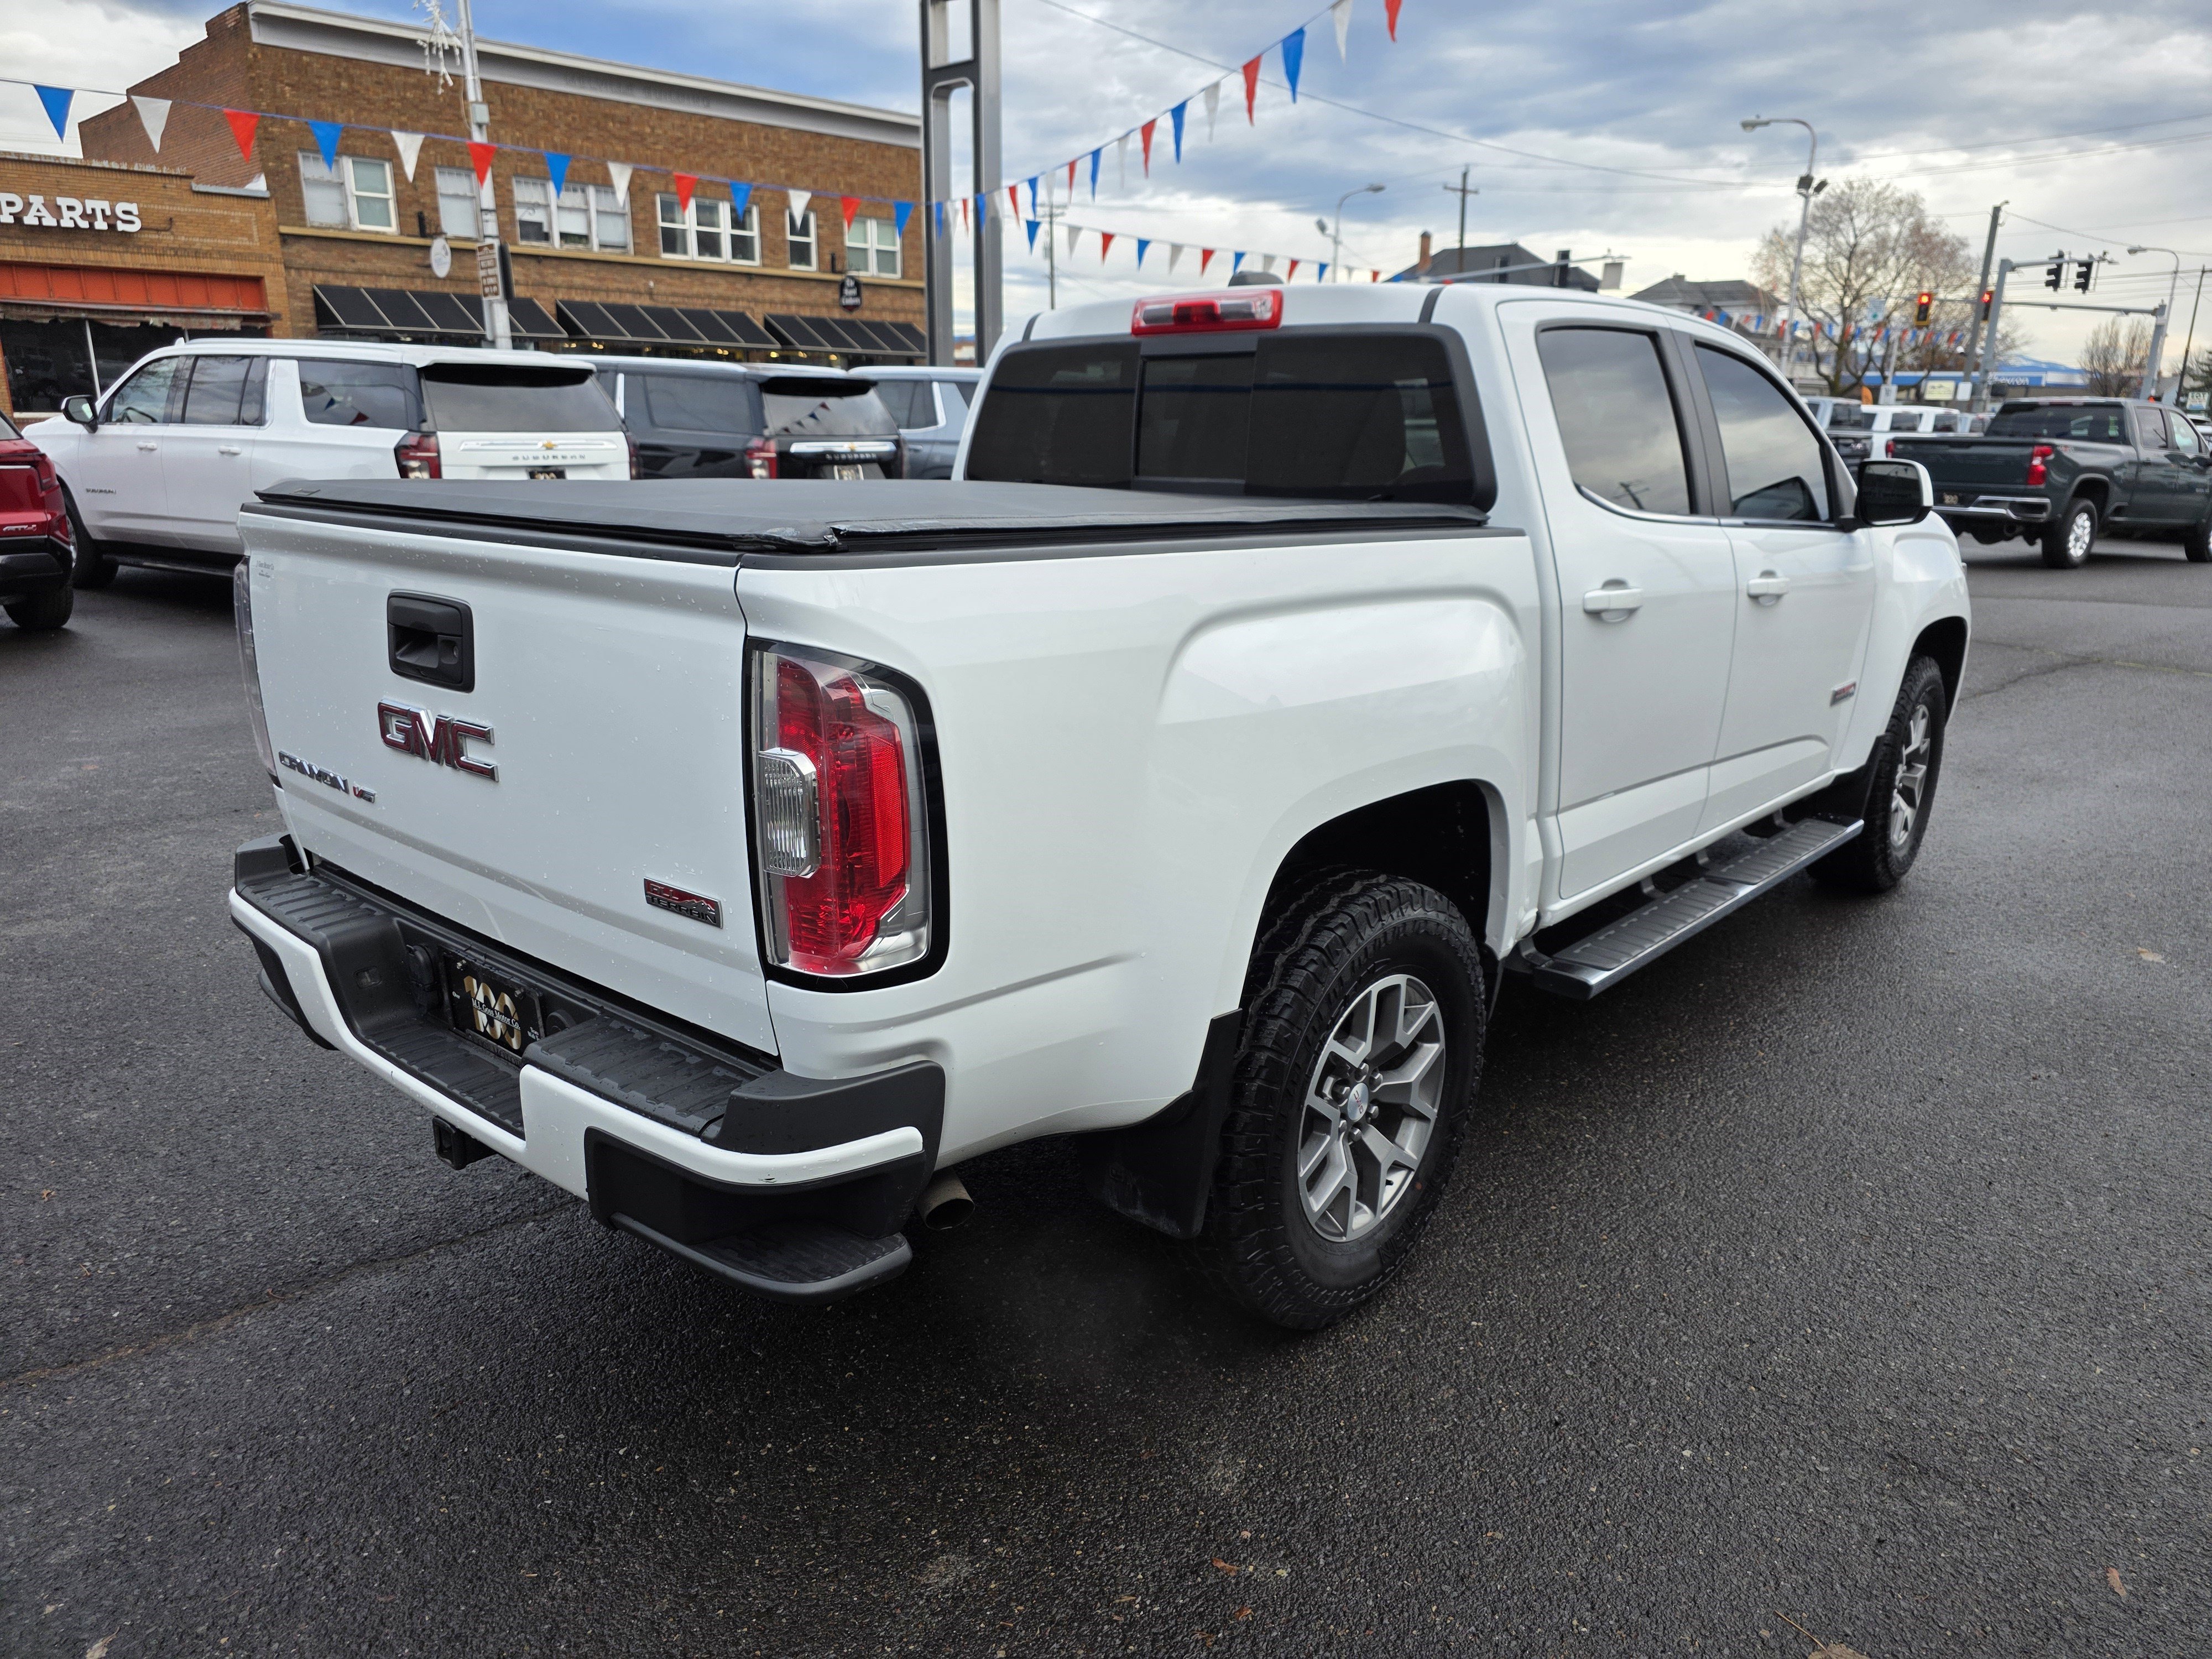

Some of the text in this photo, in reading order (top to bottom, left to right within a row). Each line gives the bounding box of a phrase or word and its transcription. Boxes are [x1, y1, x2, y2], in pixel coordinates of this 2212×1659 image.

[0, 192, 142, 233] PARTS
[378, 698, 499, 782] GMC
[279, 750, 377, 804] CANYON V6
[649, 883, 679, 900] ALL
[645, 894, 717, 925] TERRAIN
[482, 1004, 495, 1016] Goss
[494, 1010, 510, 1024] Motor
[1353, 1090, 1364, 1114] GMC
